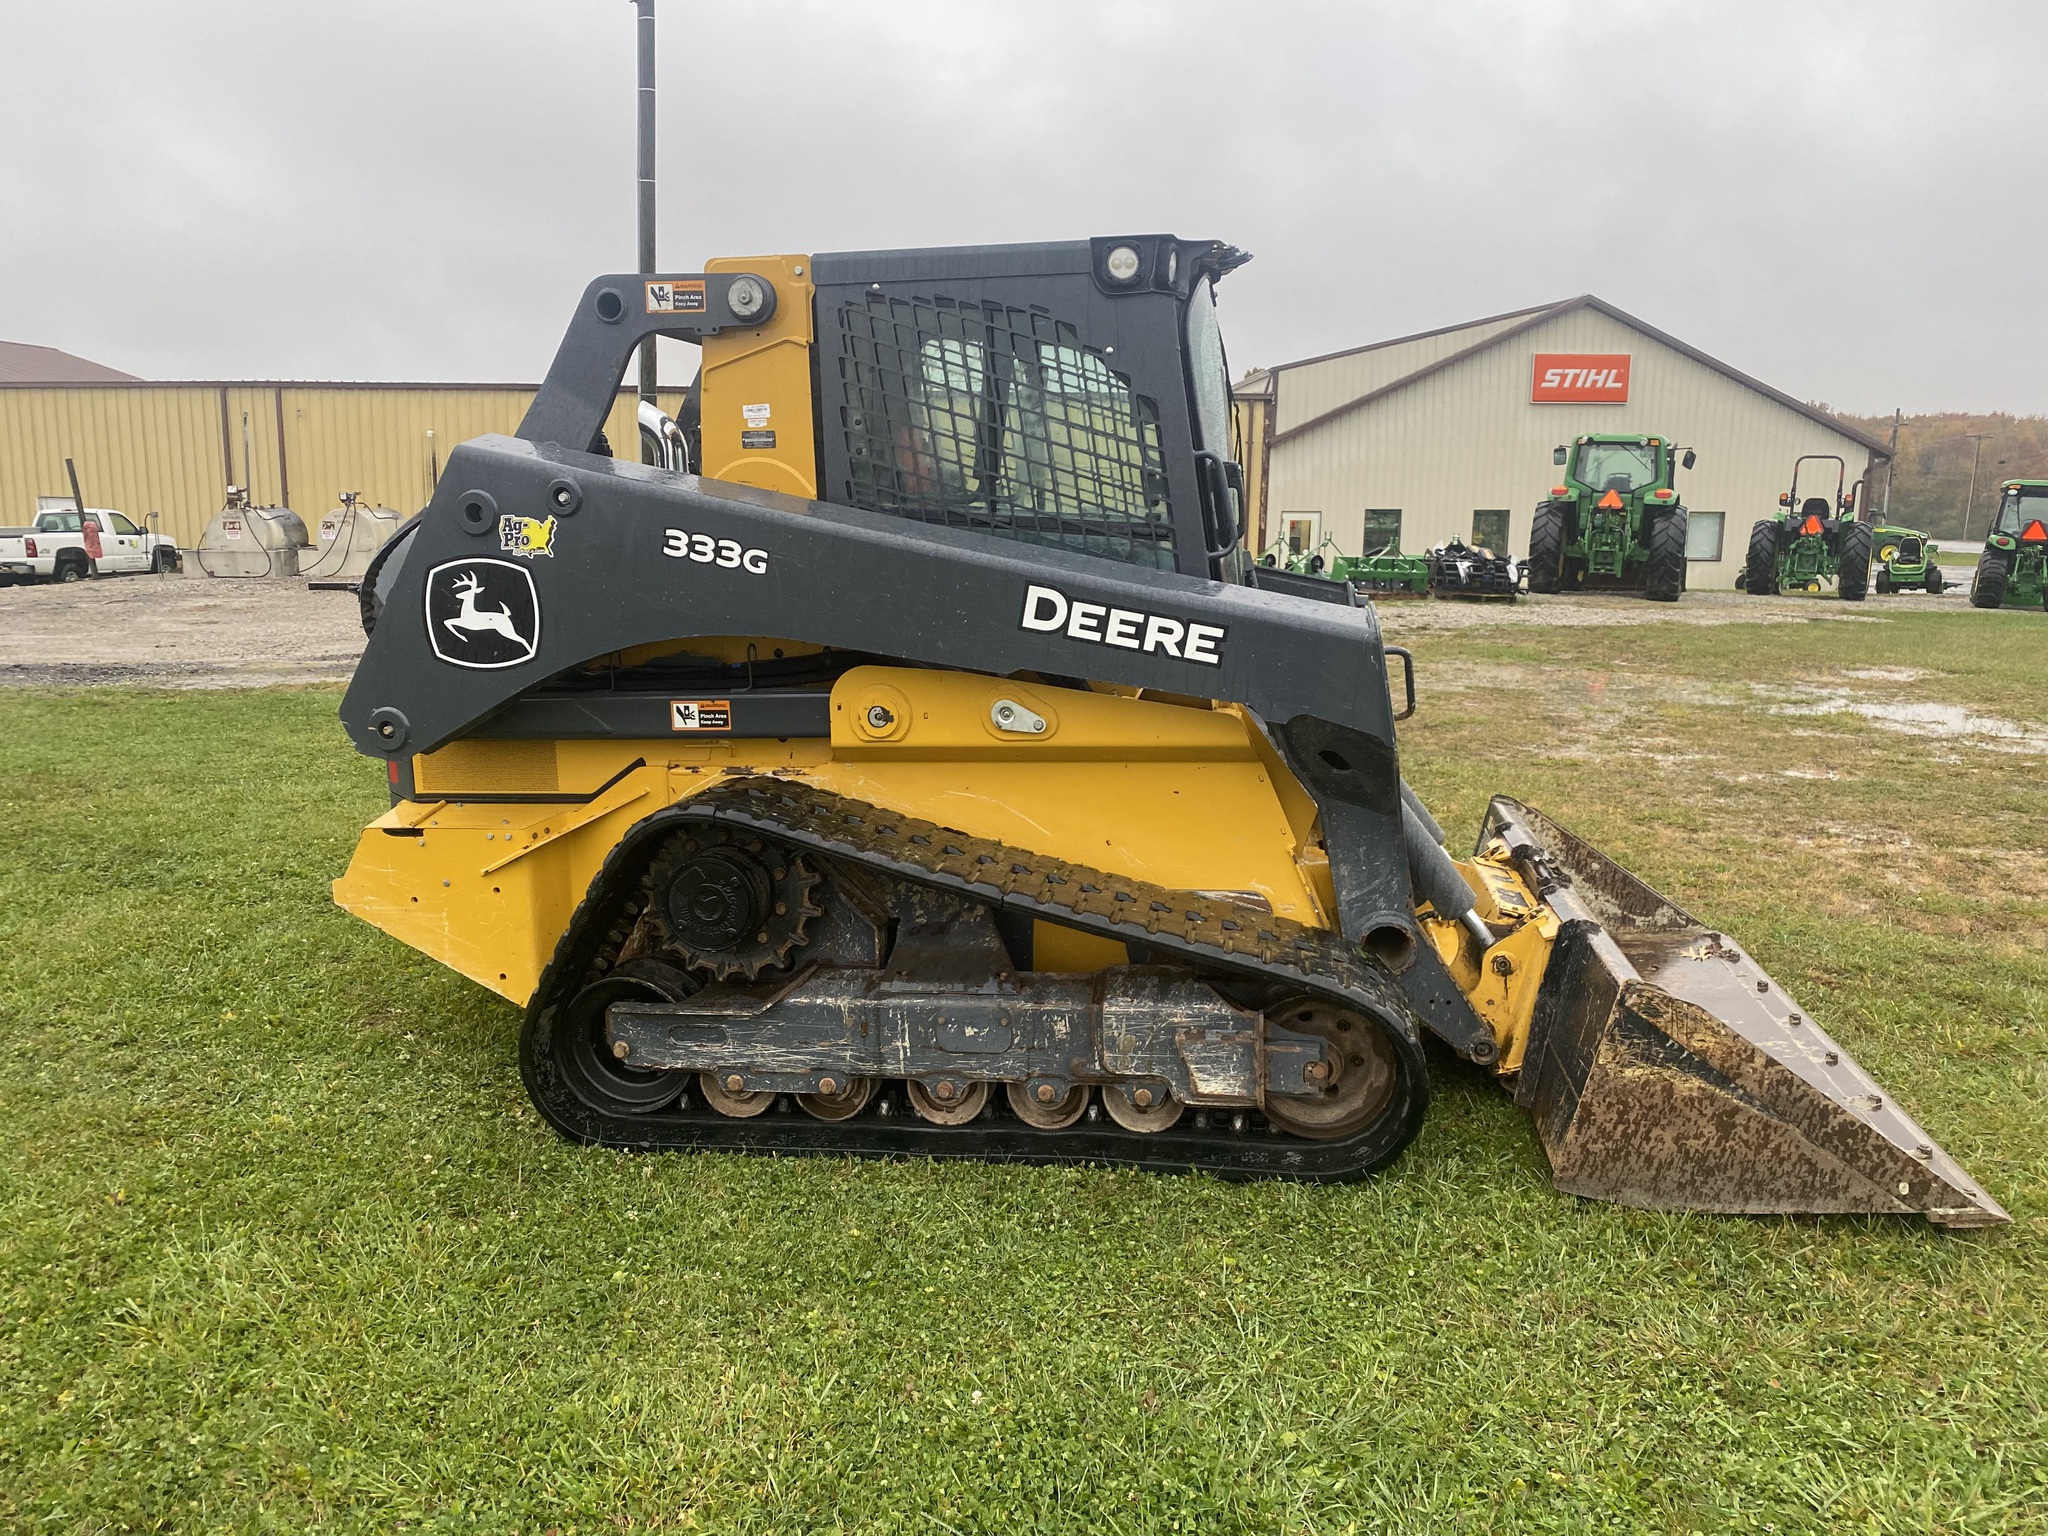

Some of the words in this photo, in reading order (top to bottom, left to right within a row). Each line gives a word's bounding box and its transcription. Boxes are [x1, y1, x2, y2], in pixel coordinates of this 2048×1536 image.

[1541, 369, 1623, 388] STIHL
[503, 518, 528, 534] Ag-
[504, 533, 530, 547] Pro
[663, 529, 768, 574] 333G
[1022, 585, 1225, 664] DEERE
